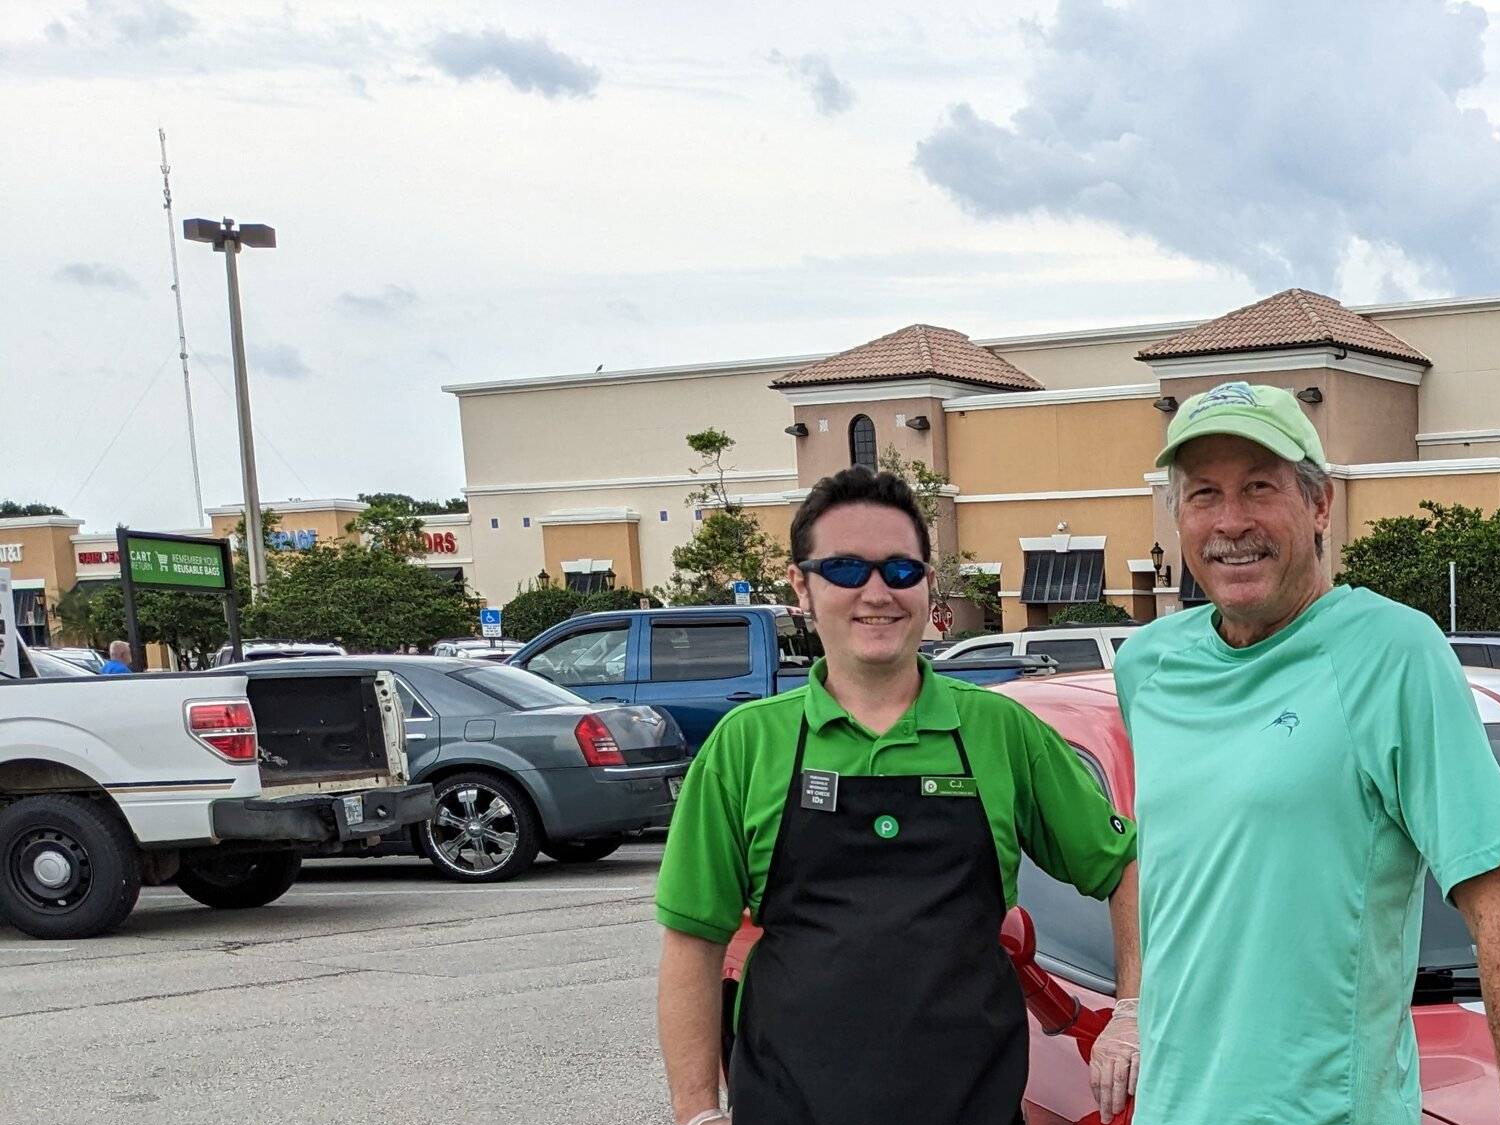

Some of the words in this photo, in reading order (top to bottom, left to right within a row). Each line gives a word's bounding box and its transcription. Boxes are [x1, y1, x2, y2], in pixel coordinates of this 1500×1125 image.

[130, 551, 151, 562] CART
[173, 564, 204, 575] REUSABLE
[205, 566, 220, 576] BAGS
